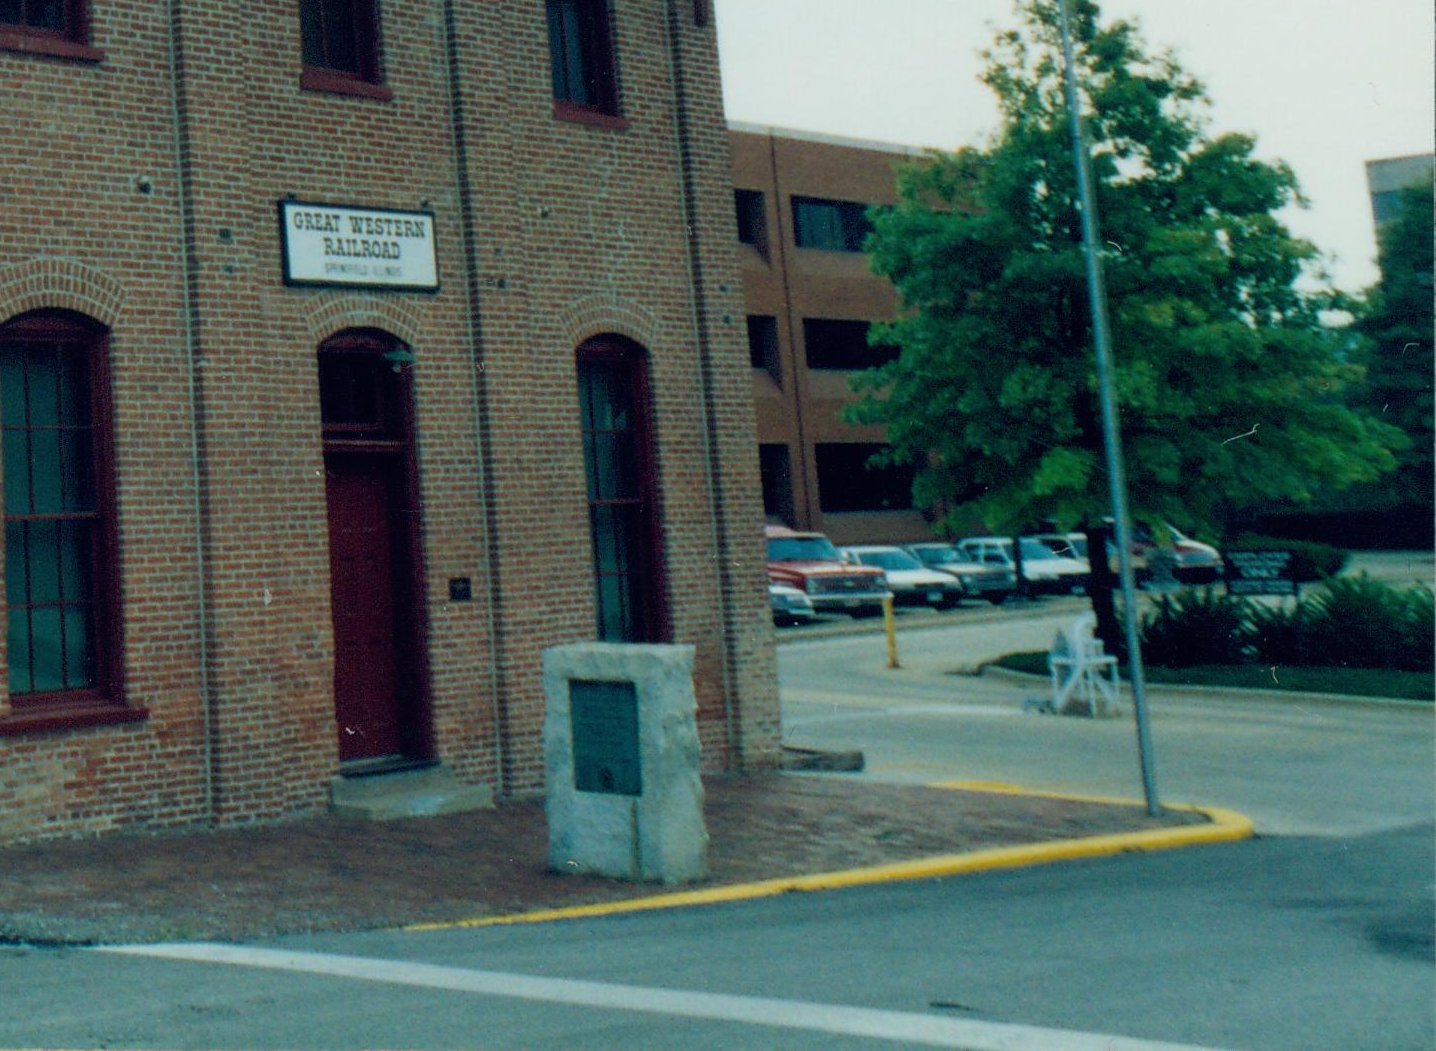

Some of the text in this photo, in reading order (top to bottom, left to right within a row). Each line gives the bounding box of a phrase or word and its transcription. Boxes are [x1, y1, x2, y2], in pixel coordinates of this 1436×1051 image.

[293, 211, 426, 239] GREAT WESTERN
[323, 238, 401, 260] RAILROAD
